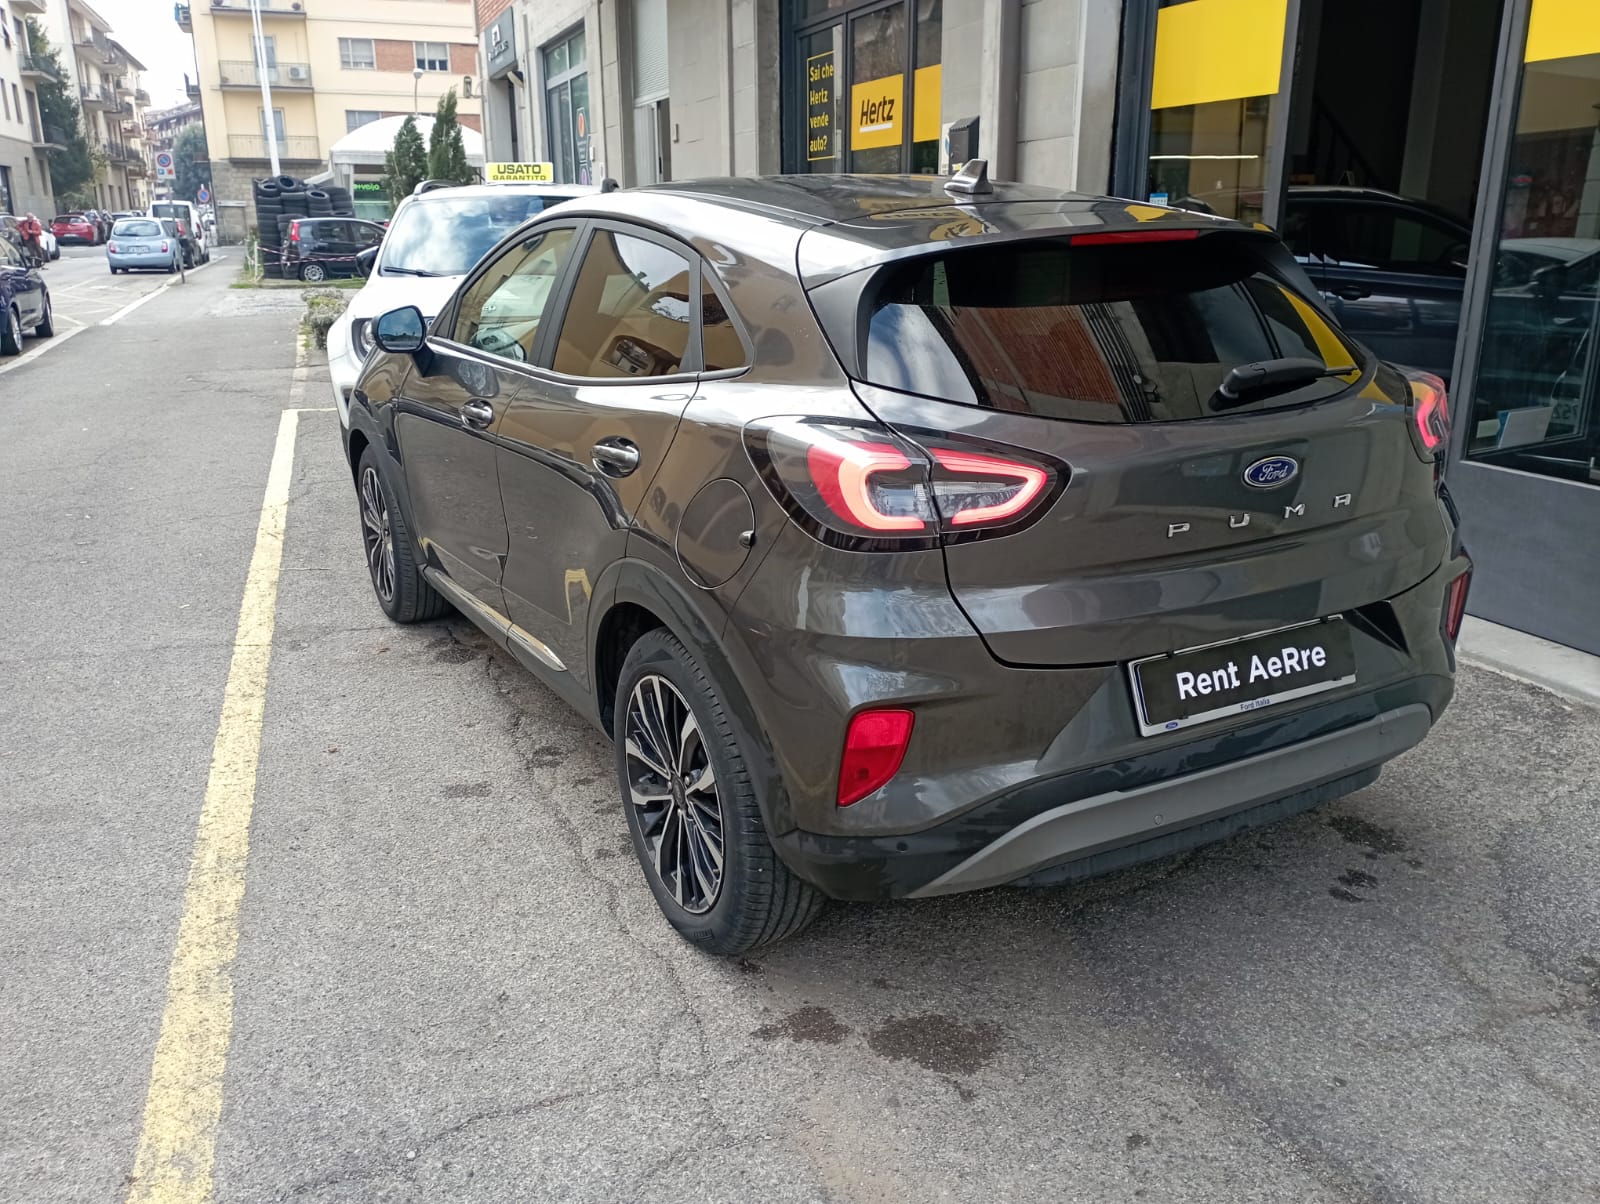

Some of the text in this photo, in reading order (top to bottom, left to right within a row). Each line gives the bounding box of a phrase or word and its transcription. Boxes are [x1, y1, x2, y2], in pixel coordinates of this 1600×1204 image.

[810, 62, 834, 82] Sai che
[810, 89, 828, 106] Hertz
[860, 96, 895, 126] Hertz
[810, 113, 829, 129] vende
[809, 135, 828, 152] auto?
[496, 163, 542, 175] USATO
[1258, 462, 1289, 482] Ford
